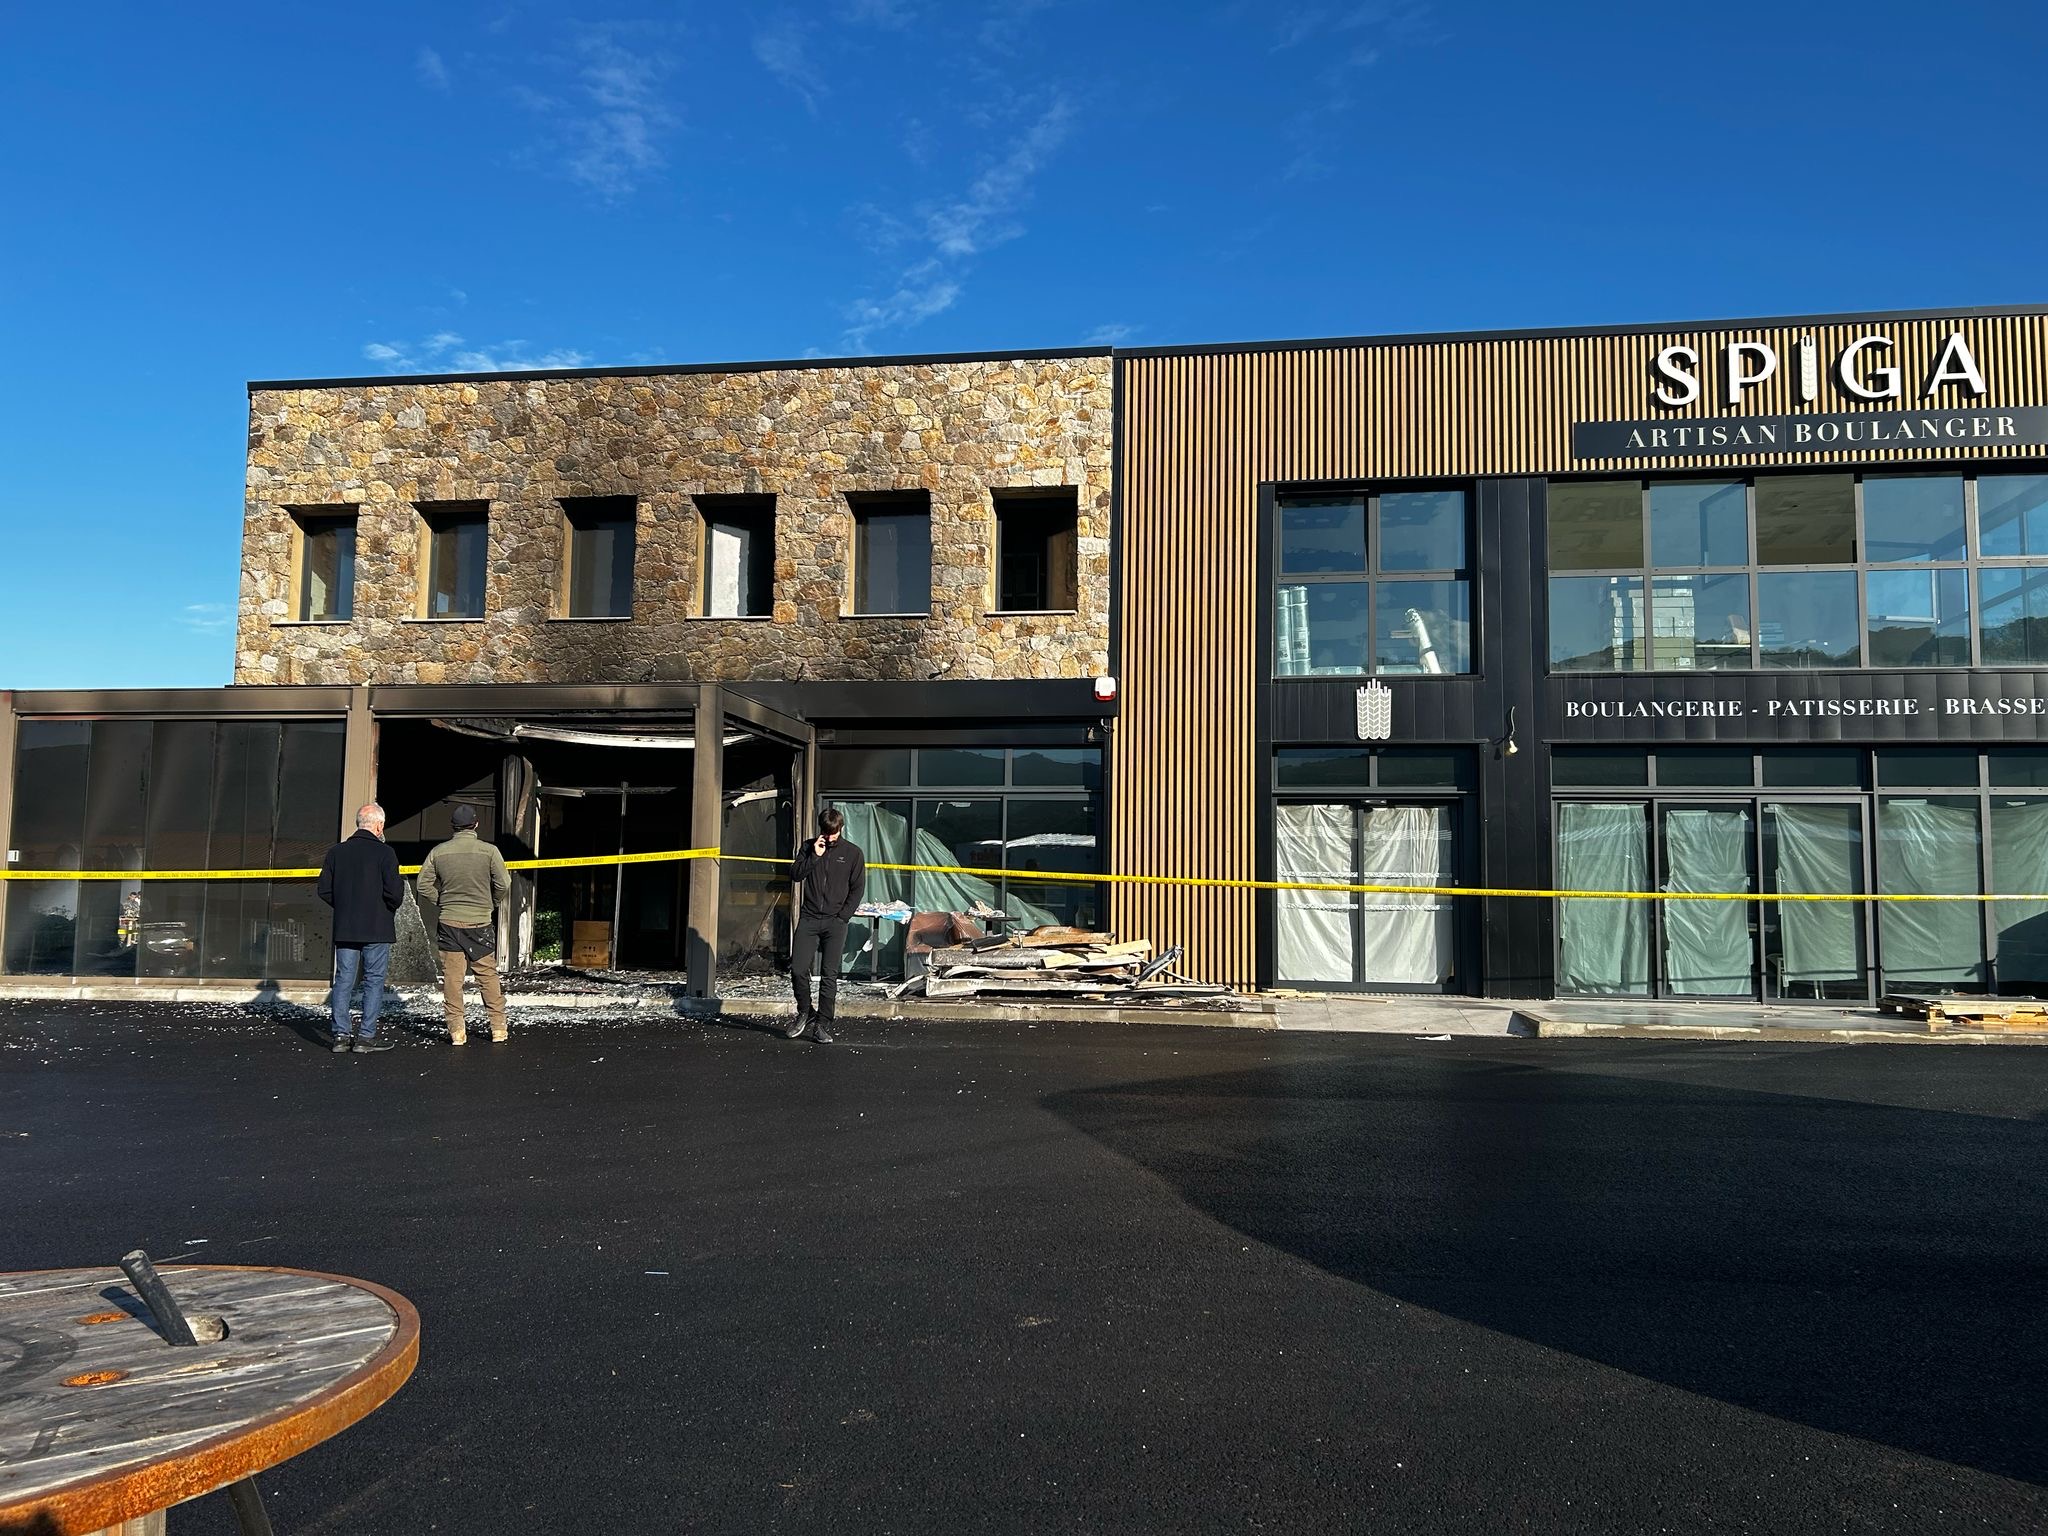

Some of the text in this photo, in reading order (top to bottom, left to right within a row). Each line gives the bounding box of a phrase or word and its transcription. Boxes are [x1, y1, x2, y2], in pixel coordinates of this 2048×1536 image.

[1656, 332, 1987, 406] SPIGA
[1625, 416, 2017, 449] ARTISAN BOULANGER
[1565, 701, 1743, 718] BOULANGERIE
[1767, 699, 1919, 717] PATISSERIE
[1944, 697, 2048, 715] BRASSE
